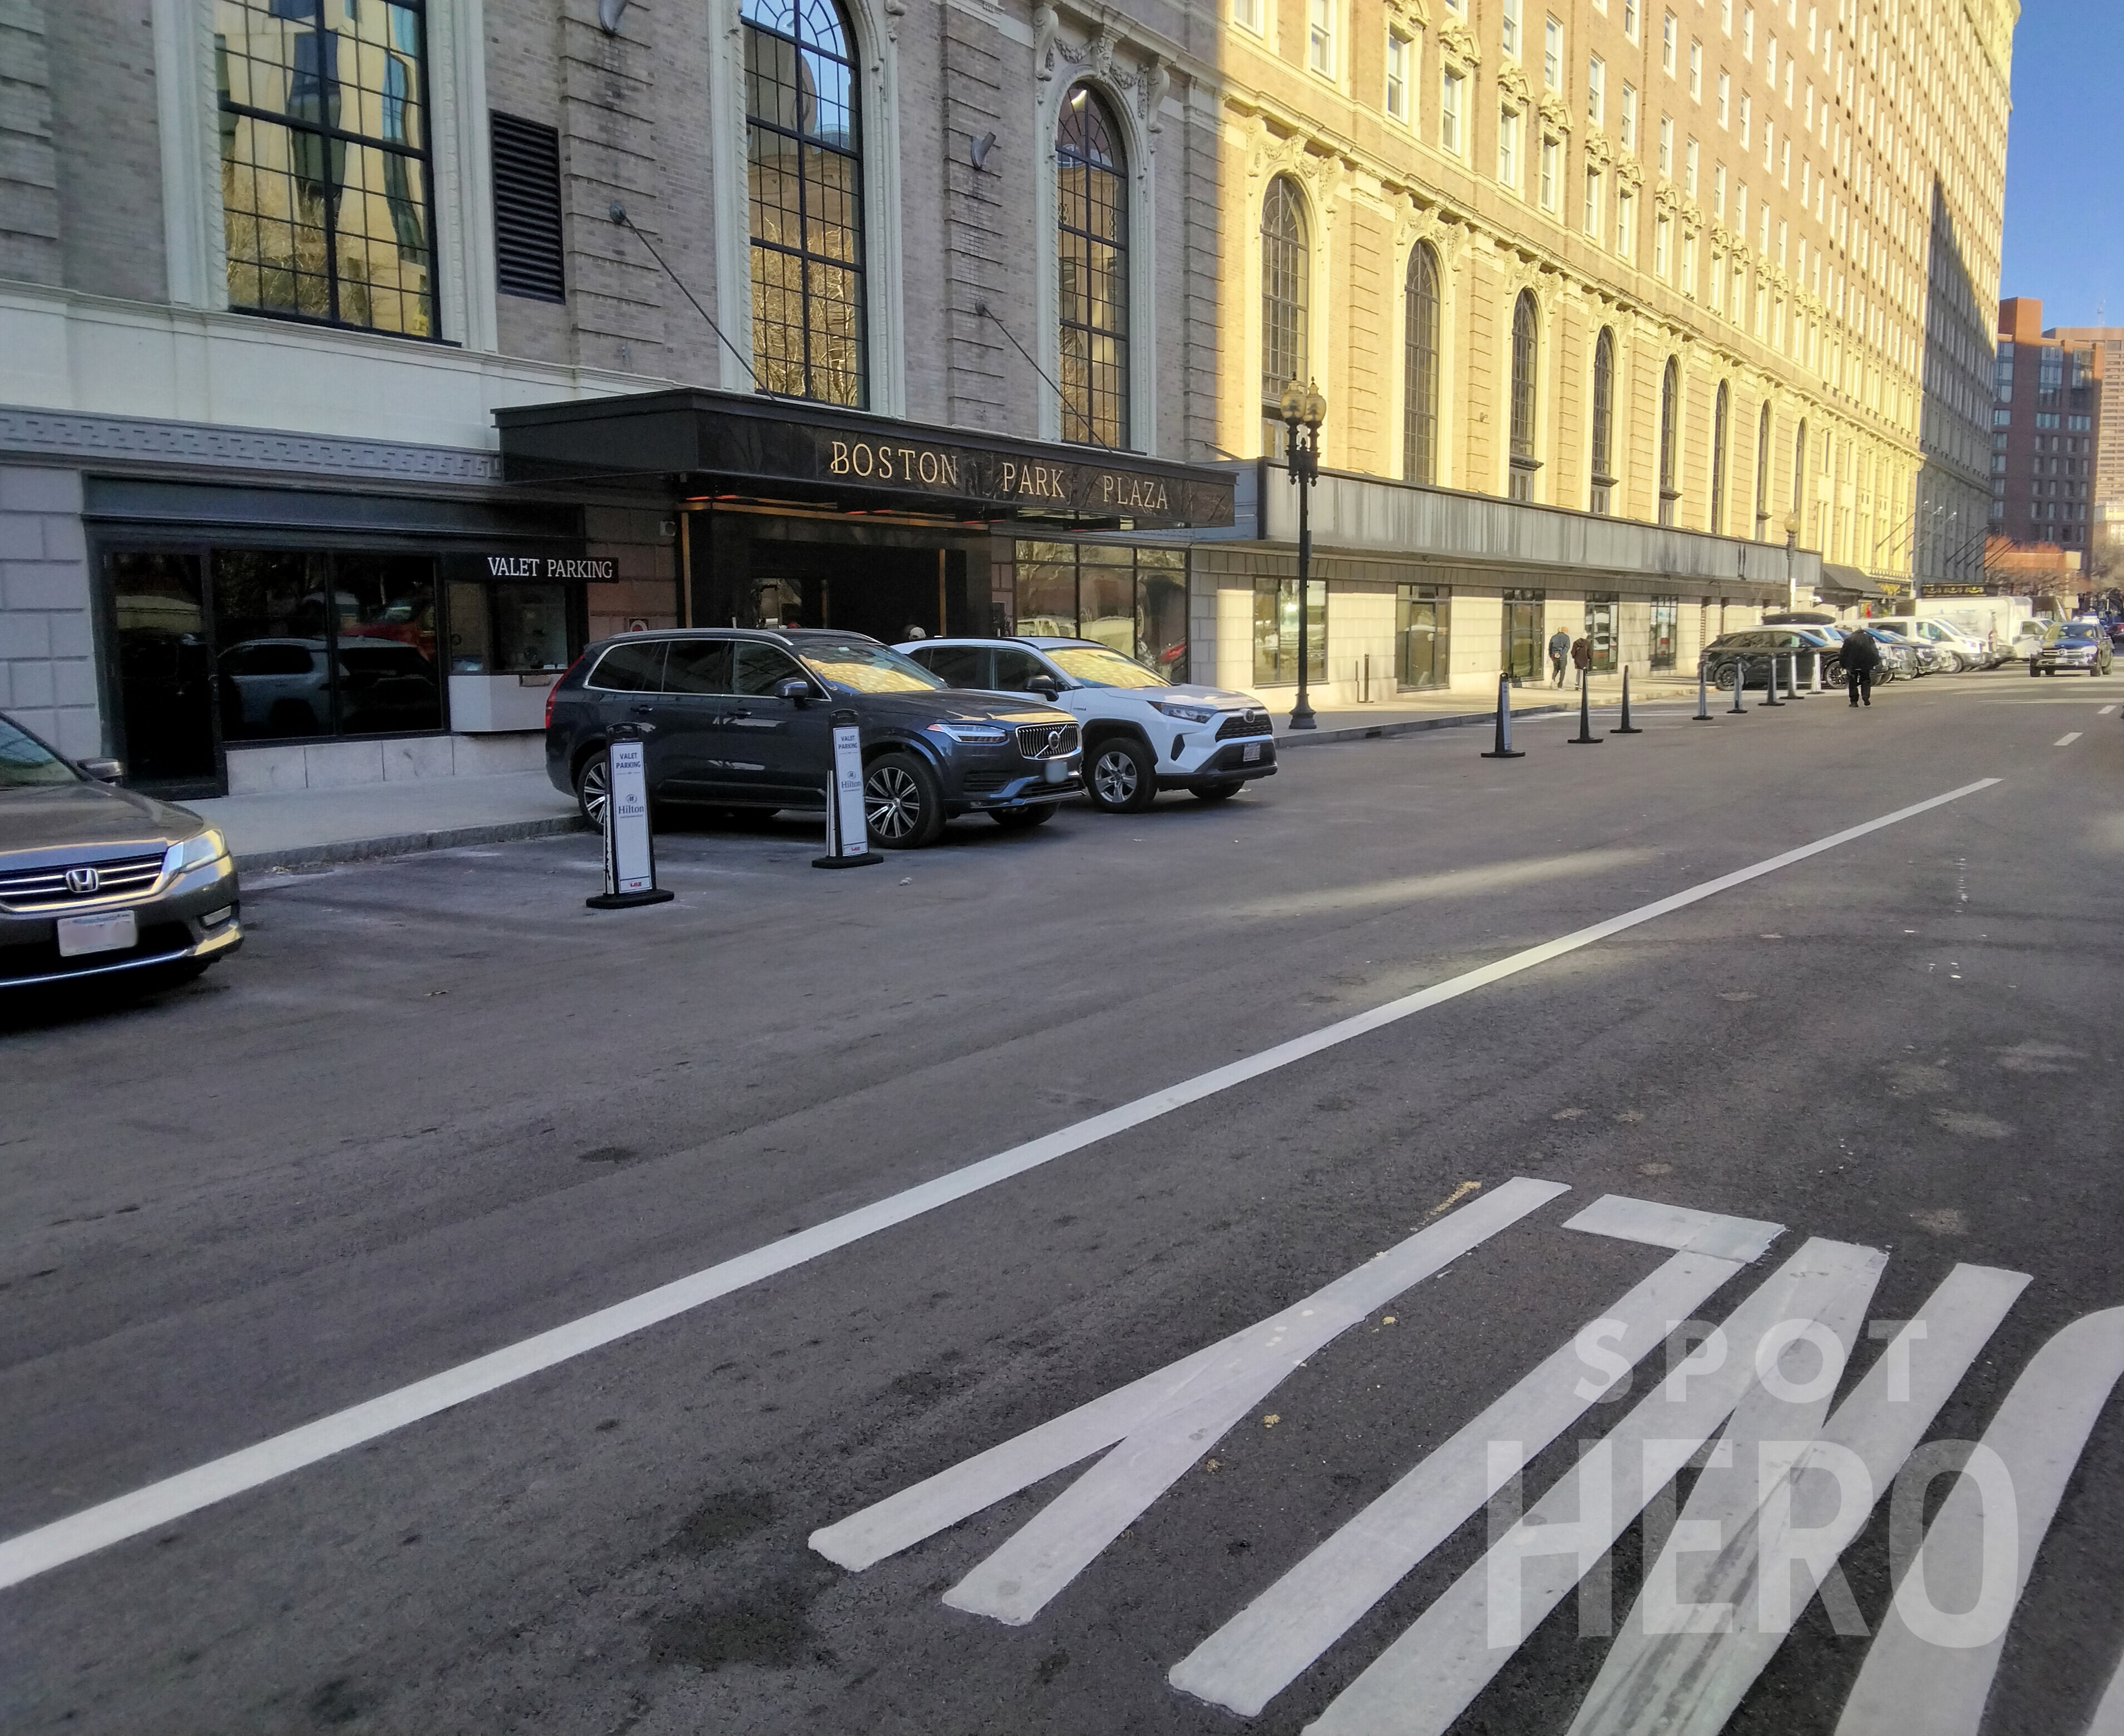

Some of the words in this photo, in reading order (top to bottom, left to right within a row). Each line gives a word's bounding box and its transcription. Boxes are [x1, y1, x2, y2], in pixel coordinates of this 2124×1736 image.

[830, 441, 957, 485] BOSTON
[1002, 462, 1066, 498] PARK
[1102, 475, 1169, 509] PLAZA
[487, 557, 540, 576] VALET
[547, 559, 613, 579] PARKING
[616, 761, 641, 769] PARKING
[619, 805, 644, 814] Hilton
